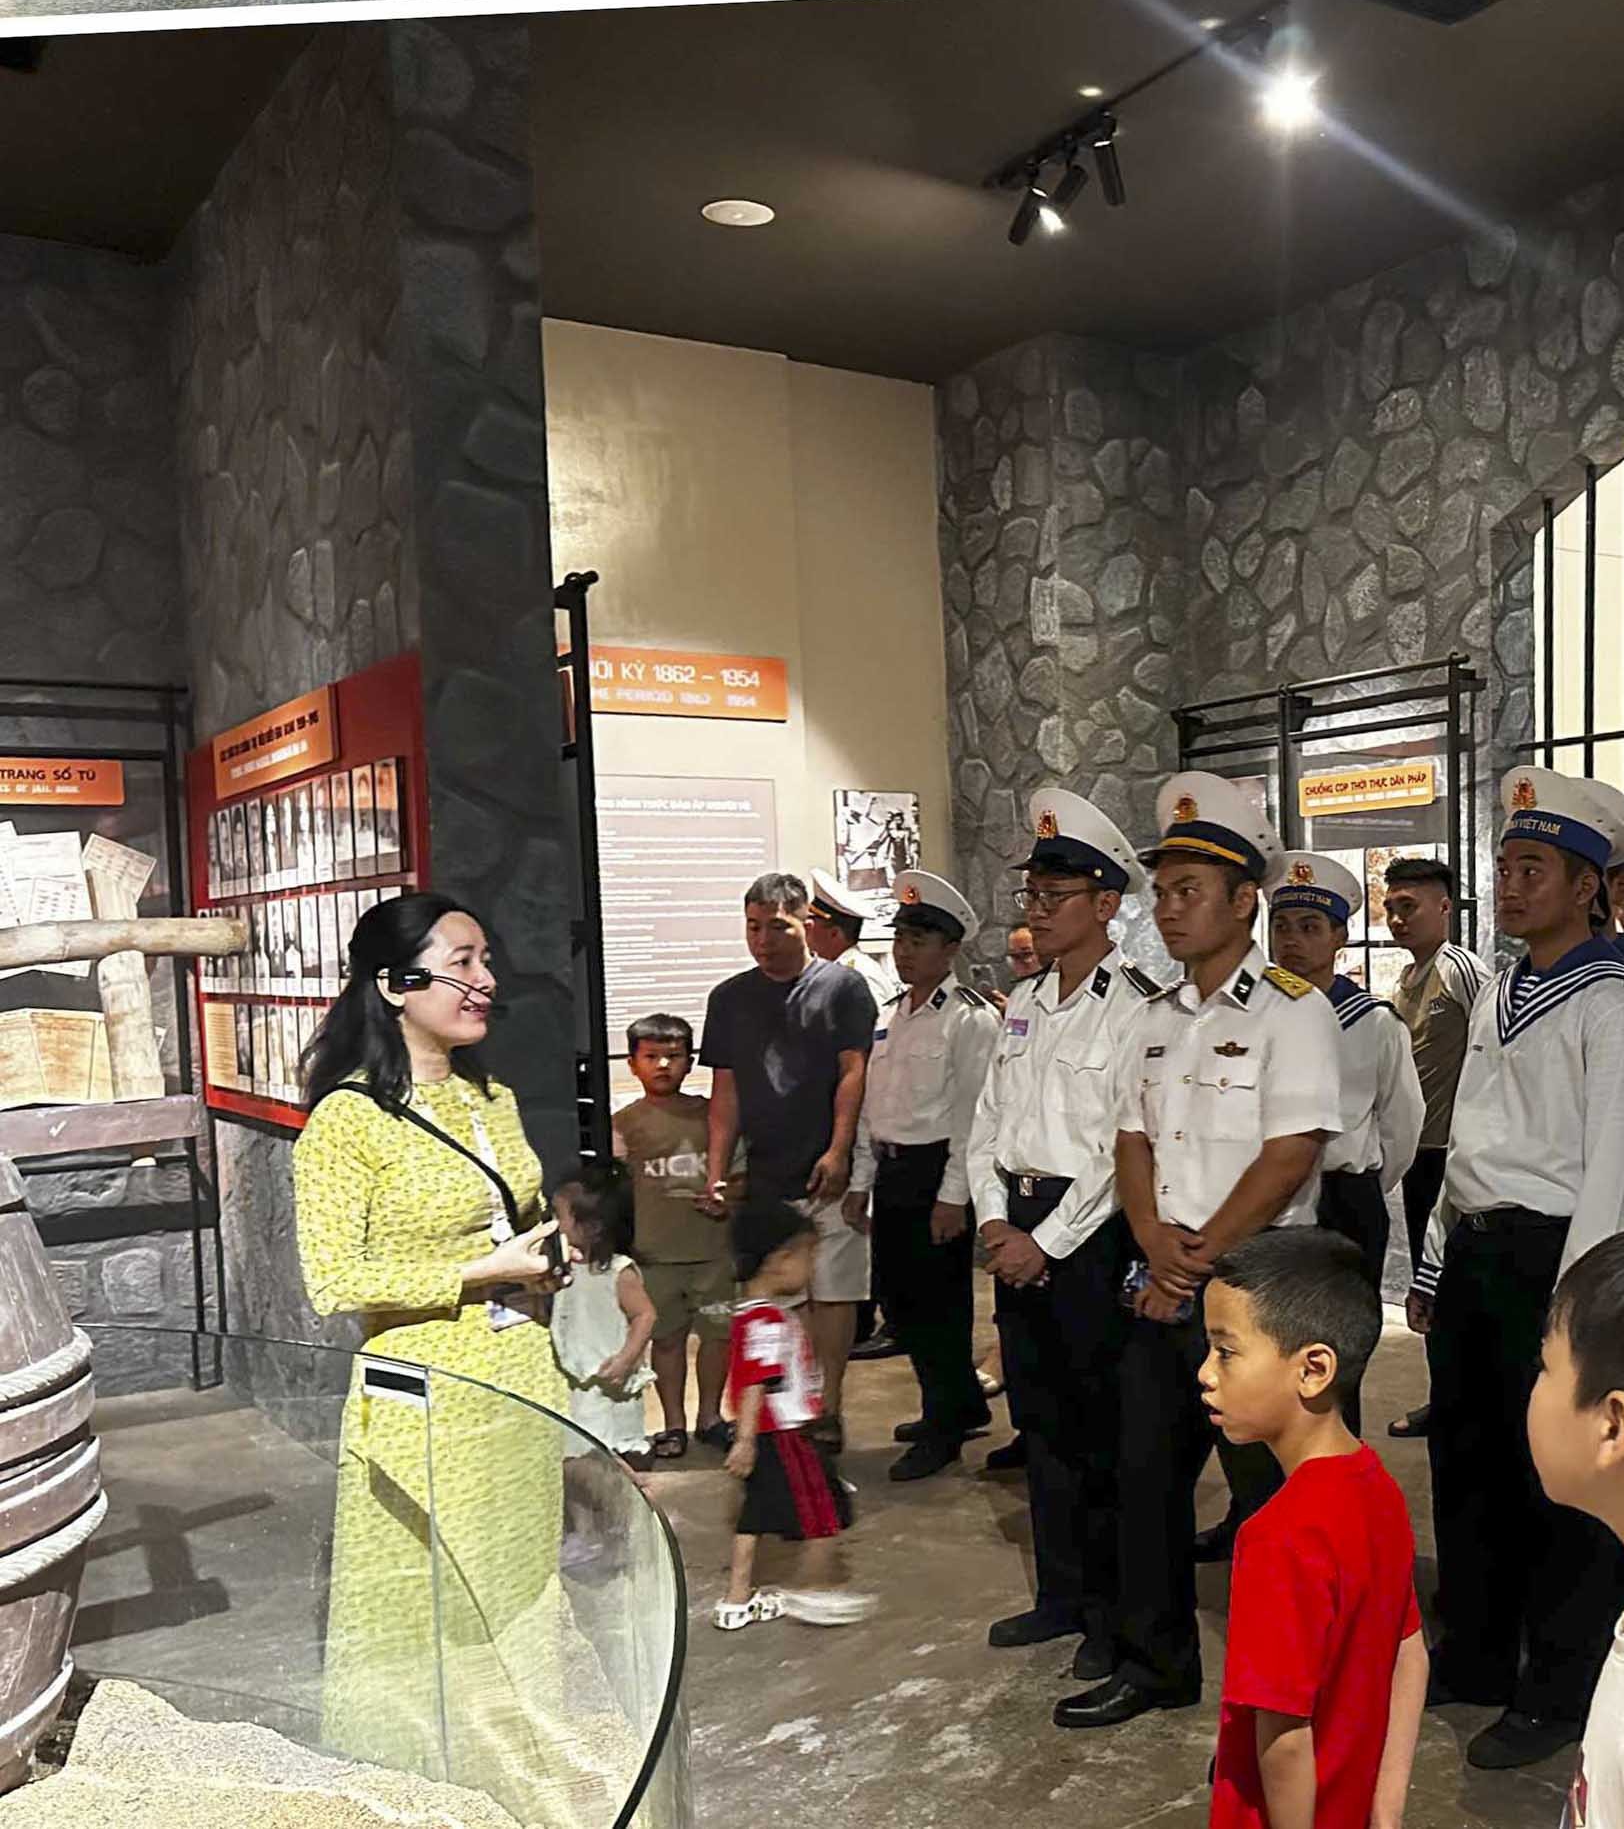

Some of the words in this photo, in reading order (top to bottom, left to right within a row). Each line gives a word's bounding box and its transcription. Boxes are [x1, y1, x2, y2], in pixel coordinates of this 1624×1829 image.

[620, 657, 646, 682] KỲ
[654, 663, 696, 684] 1862
[720, 668, 761, 688] 1954
[0, 769, 46, 781] TRANG
[53, 766, 72, 781] SỐ
[1539, 820, 1562, 836] NAM
